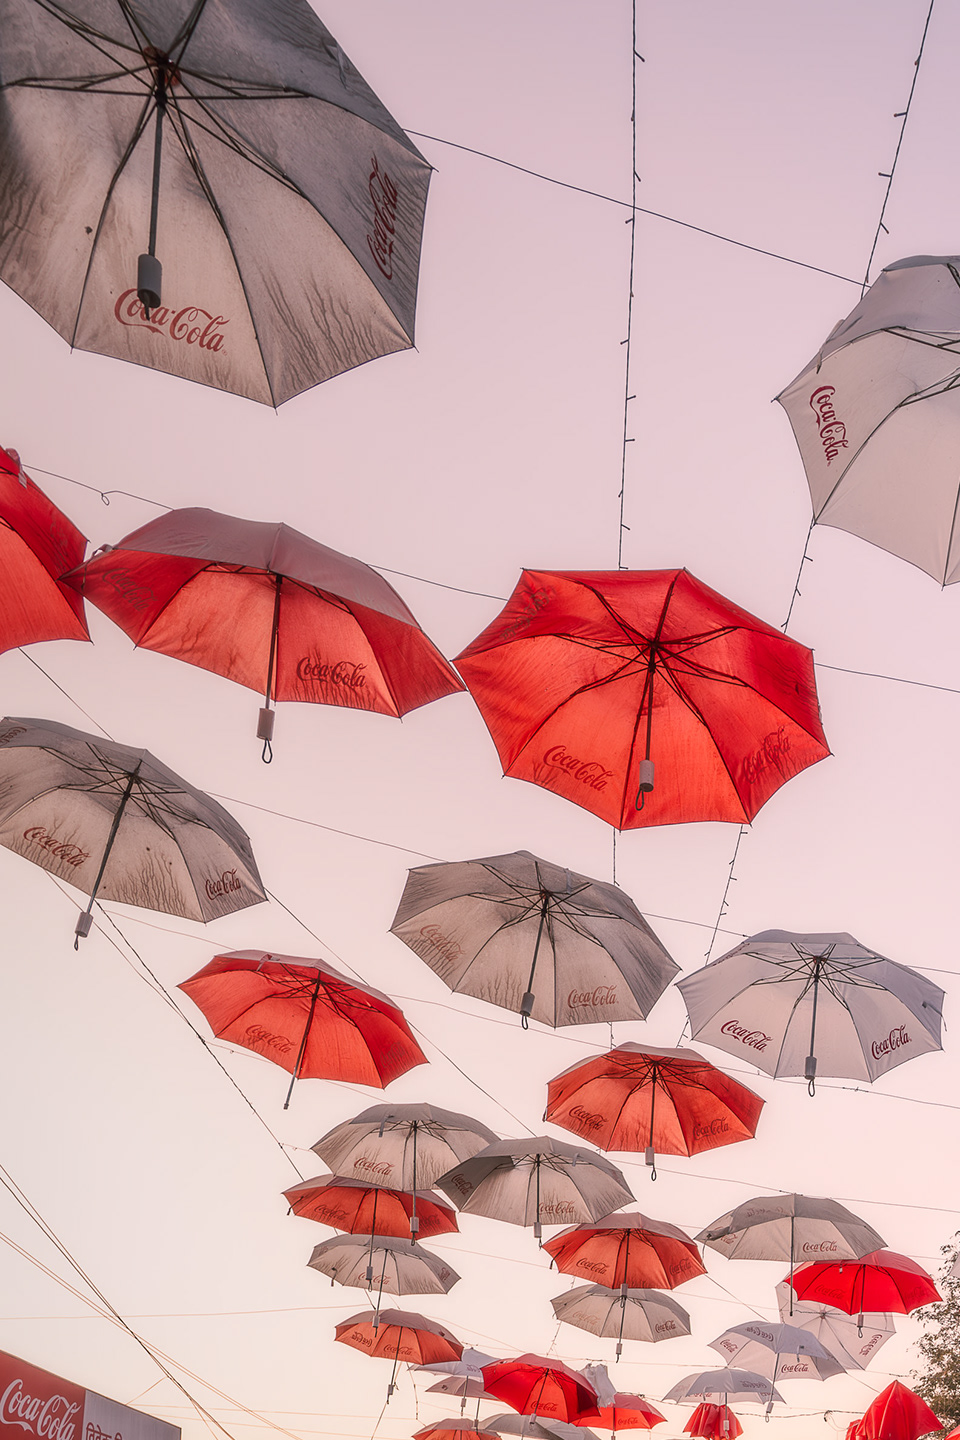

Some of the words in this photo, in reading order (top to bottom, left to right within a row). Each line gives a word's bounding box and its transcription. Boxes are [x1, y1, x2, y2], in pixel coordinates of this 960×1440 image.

[365, 152, 399, 279] Coca-Cola
[115, 287, 231, 354] Coca-Cola
[810, 386, 850, 462] Coca-Cola
[297, 658, 368, 688] Coca-Cola
[546, 745, 613, 790] Coca-Cola
[24, 826, 89, 868] Coca-Cola
[205, 868, 241, 901] Coca-Cola
[567, 985, 616, 1009] Coca-Cola
[247, 1024, 298, 1053] Coca-Cola
[721, 1020, 773, 1051] Coca-Cola
[871, 1025, 909, 1060] Coca-Cola
[569, 1105, 608, 1131] Coca-Cola
[354, 1157, 394, 1176] Coca-Cola
[803, 1241, 838, 1253] Coca-Cola
[576, 1258, 609, 1274] Coca-Cola
[655, 1320, 676, 1334] Coca-Cola
[384, 1344, 412, 1356] Coca-Cola
[781, 1363, 808, 1373] Coca-Cola
